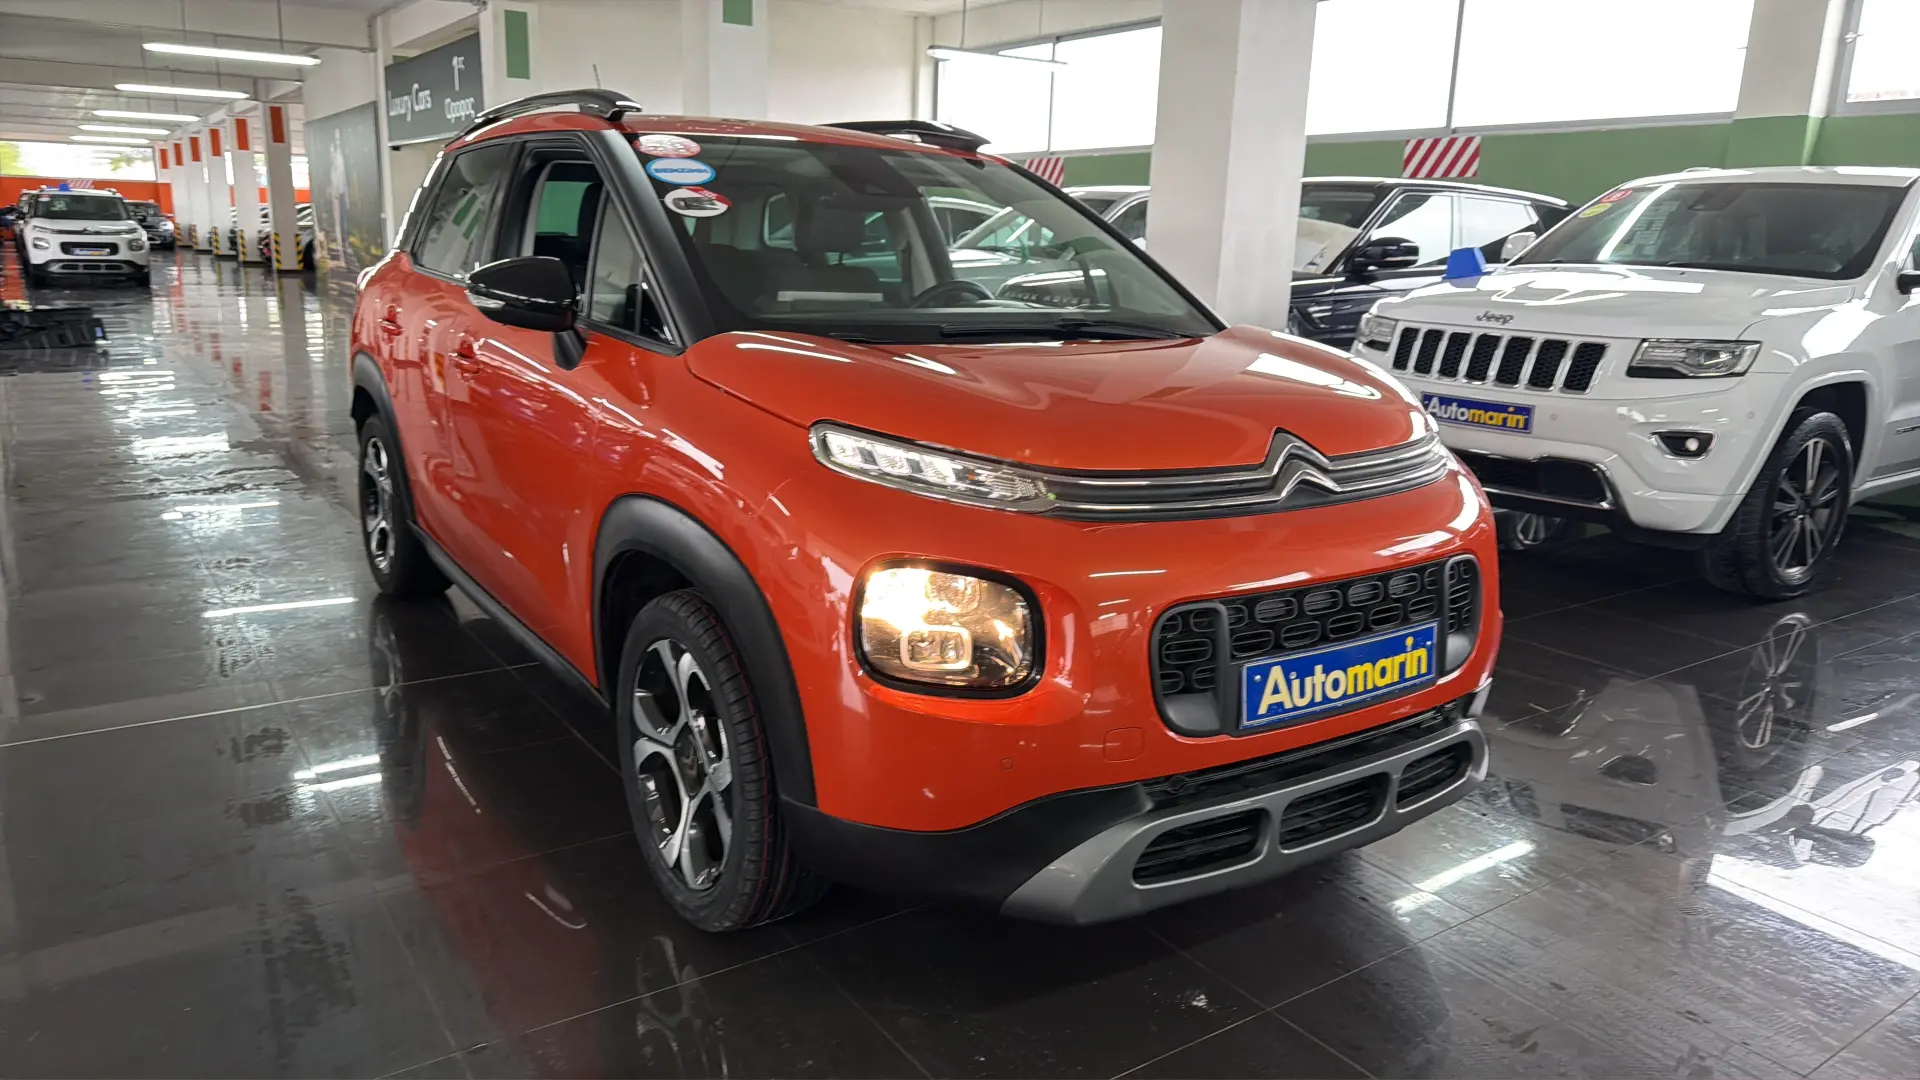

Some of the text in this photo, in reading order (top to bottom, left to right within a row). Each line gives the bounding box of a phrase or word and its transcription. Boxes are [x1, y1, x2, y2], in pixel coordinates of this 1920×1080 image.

[388, 83, 432, 122] Luxury Cars
[1476, 310, 1514, 325] Jeep
[1426, 396, 1526, 429] Automarin
[1257, 636, 1428, 715] Automarin
